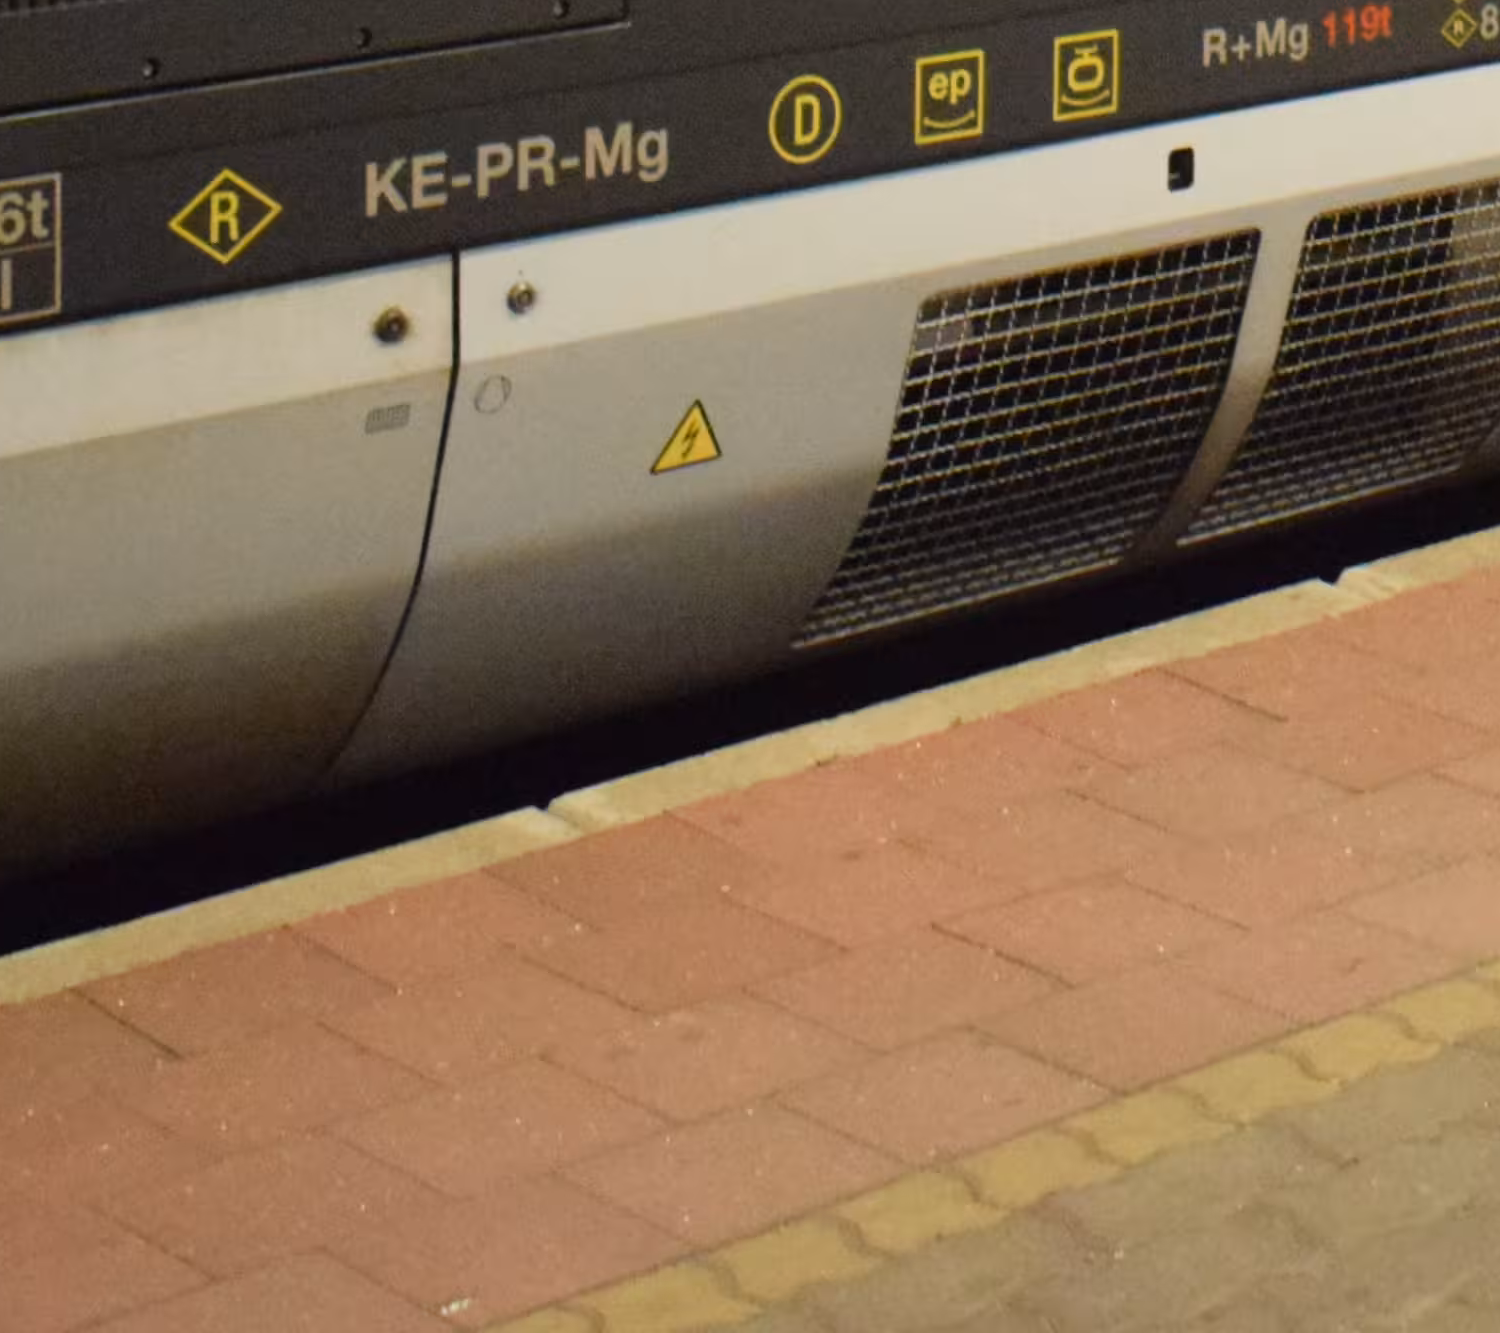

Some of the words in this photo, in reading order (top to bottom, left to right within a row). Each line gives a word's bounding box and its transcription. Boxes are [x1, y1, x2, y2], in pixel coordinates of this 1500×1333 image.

[1202, 17, 1310, 68] R+Mg
[1322, 5, 1394, 48] 119t
[927, 68, 972, 106] ep
[794, 94, 821, 146] D
[365, 122, 670, 218] KE-PR-Mg
[208, 191, 240, 246] R
